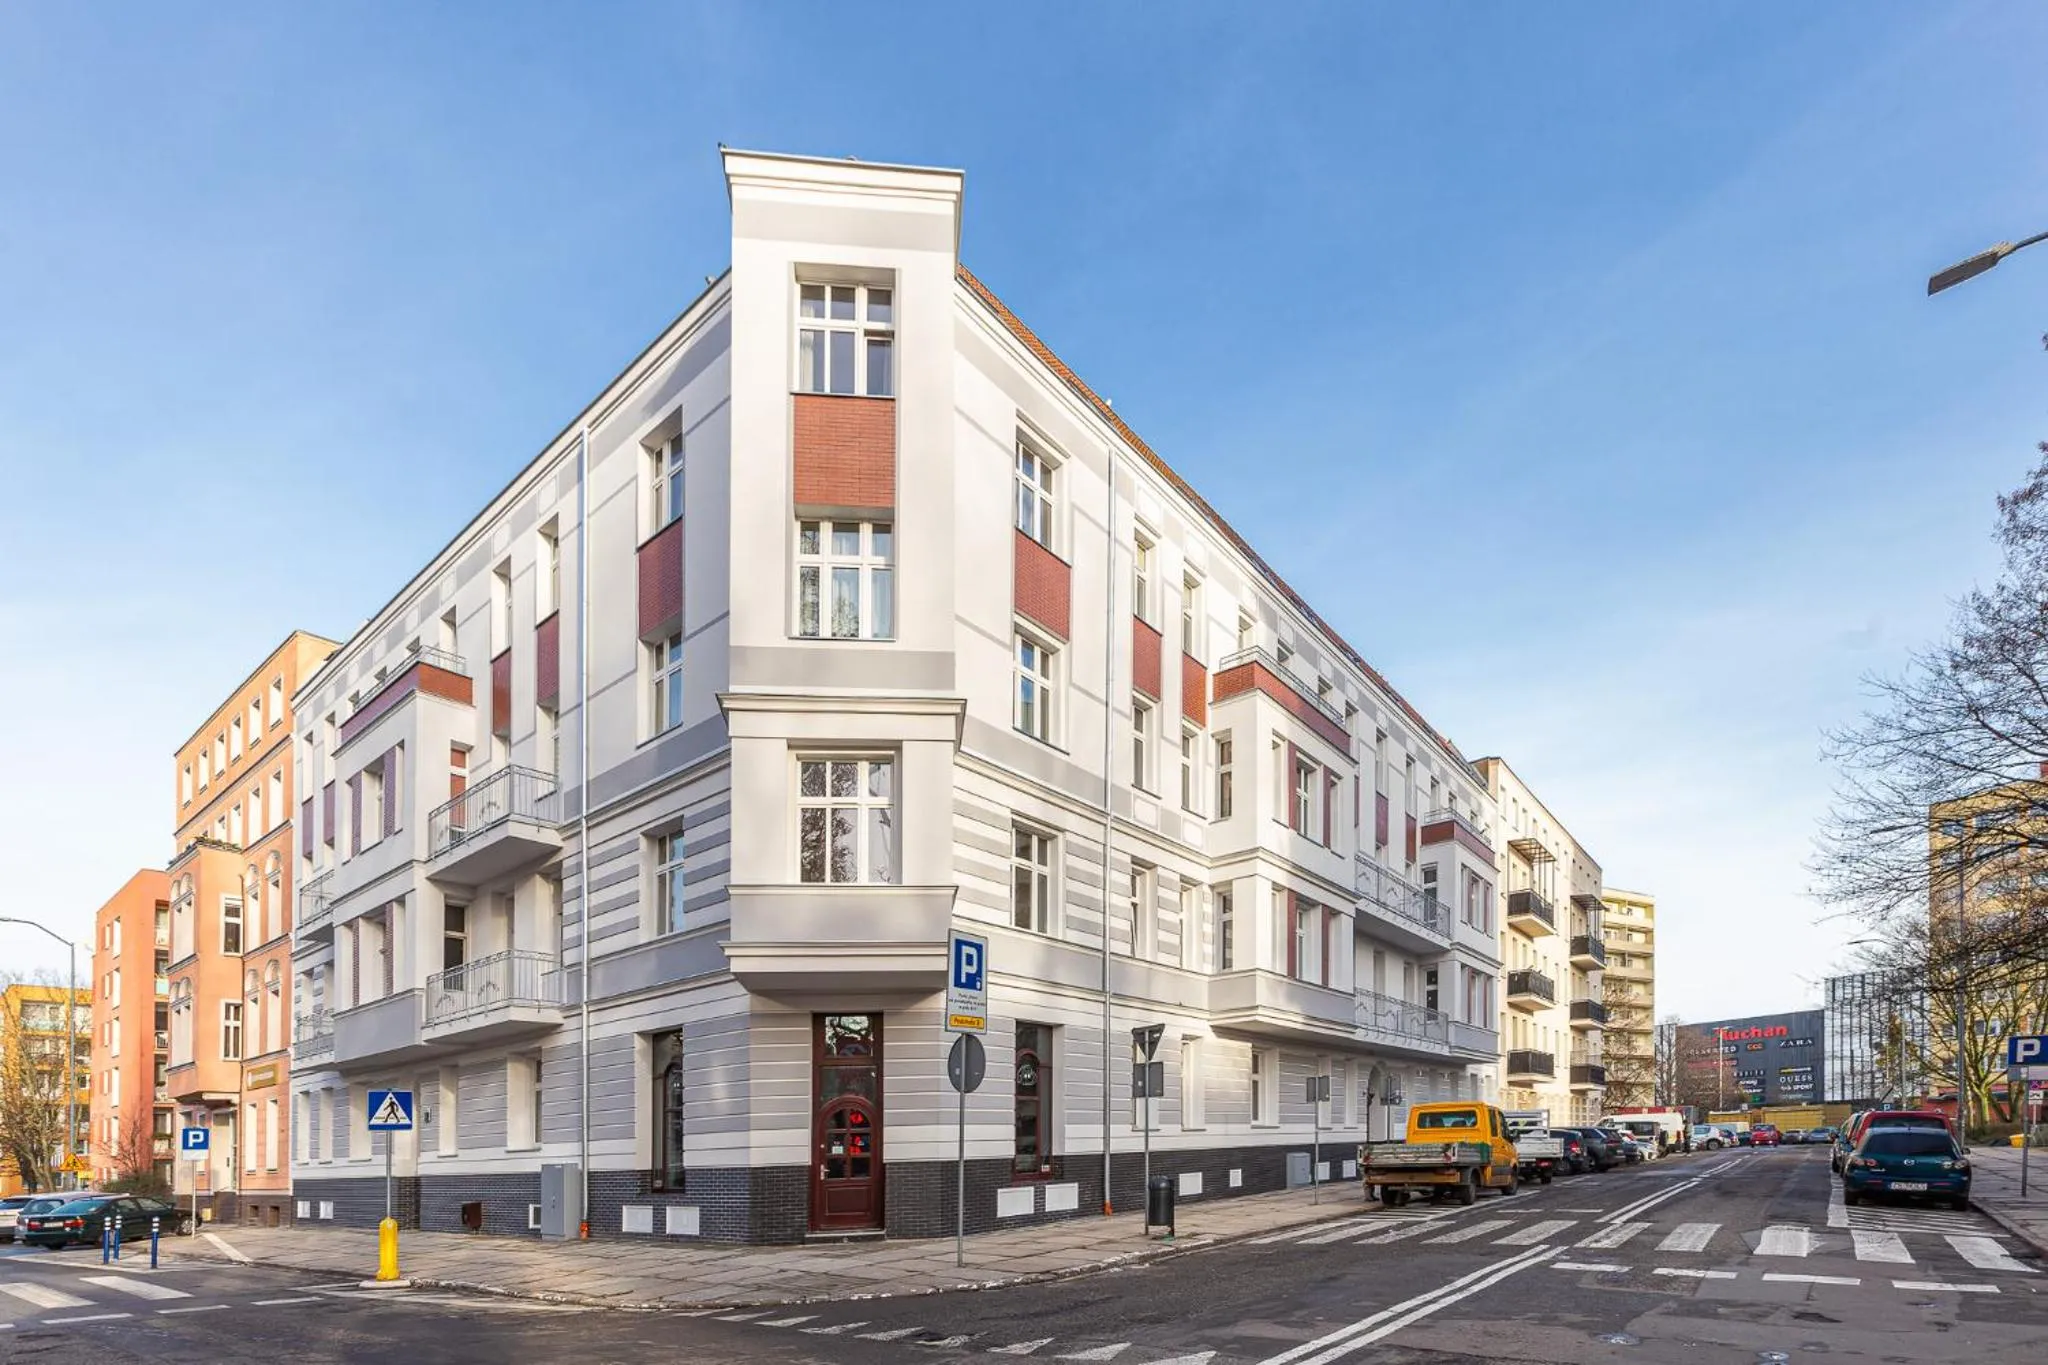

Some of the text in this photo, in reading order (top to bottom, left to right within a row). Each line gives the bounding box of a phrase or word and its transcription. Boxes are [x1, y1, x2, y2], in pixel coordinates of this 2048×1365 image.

[961, 945, 978, 983] P
[1780, 1039, 1813, 1047] ZARA
[2016, 1039, 2040, 1062] P
[188, 1131, 204, 1148] P
